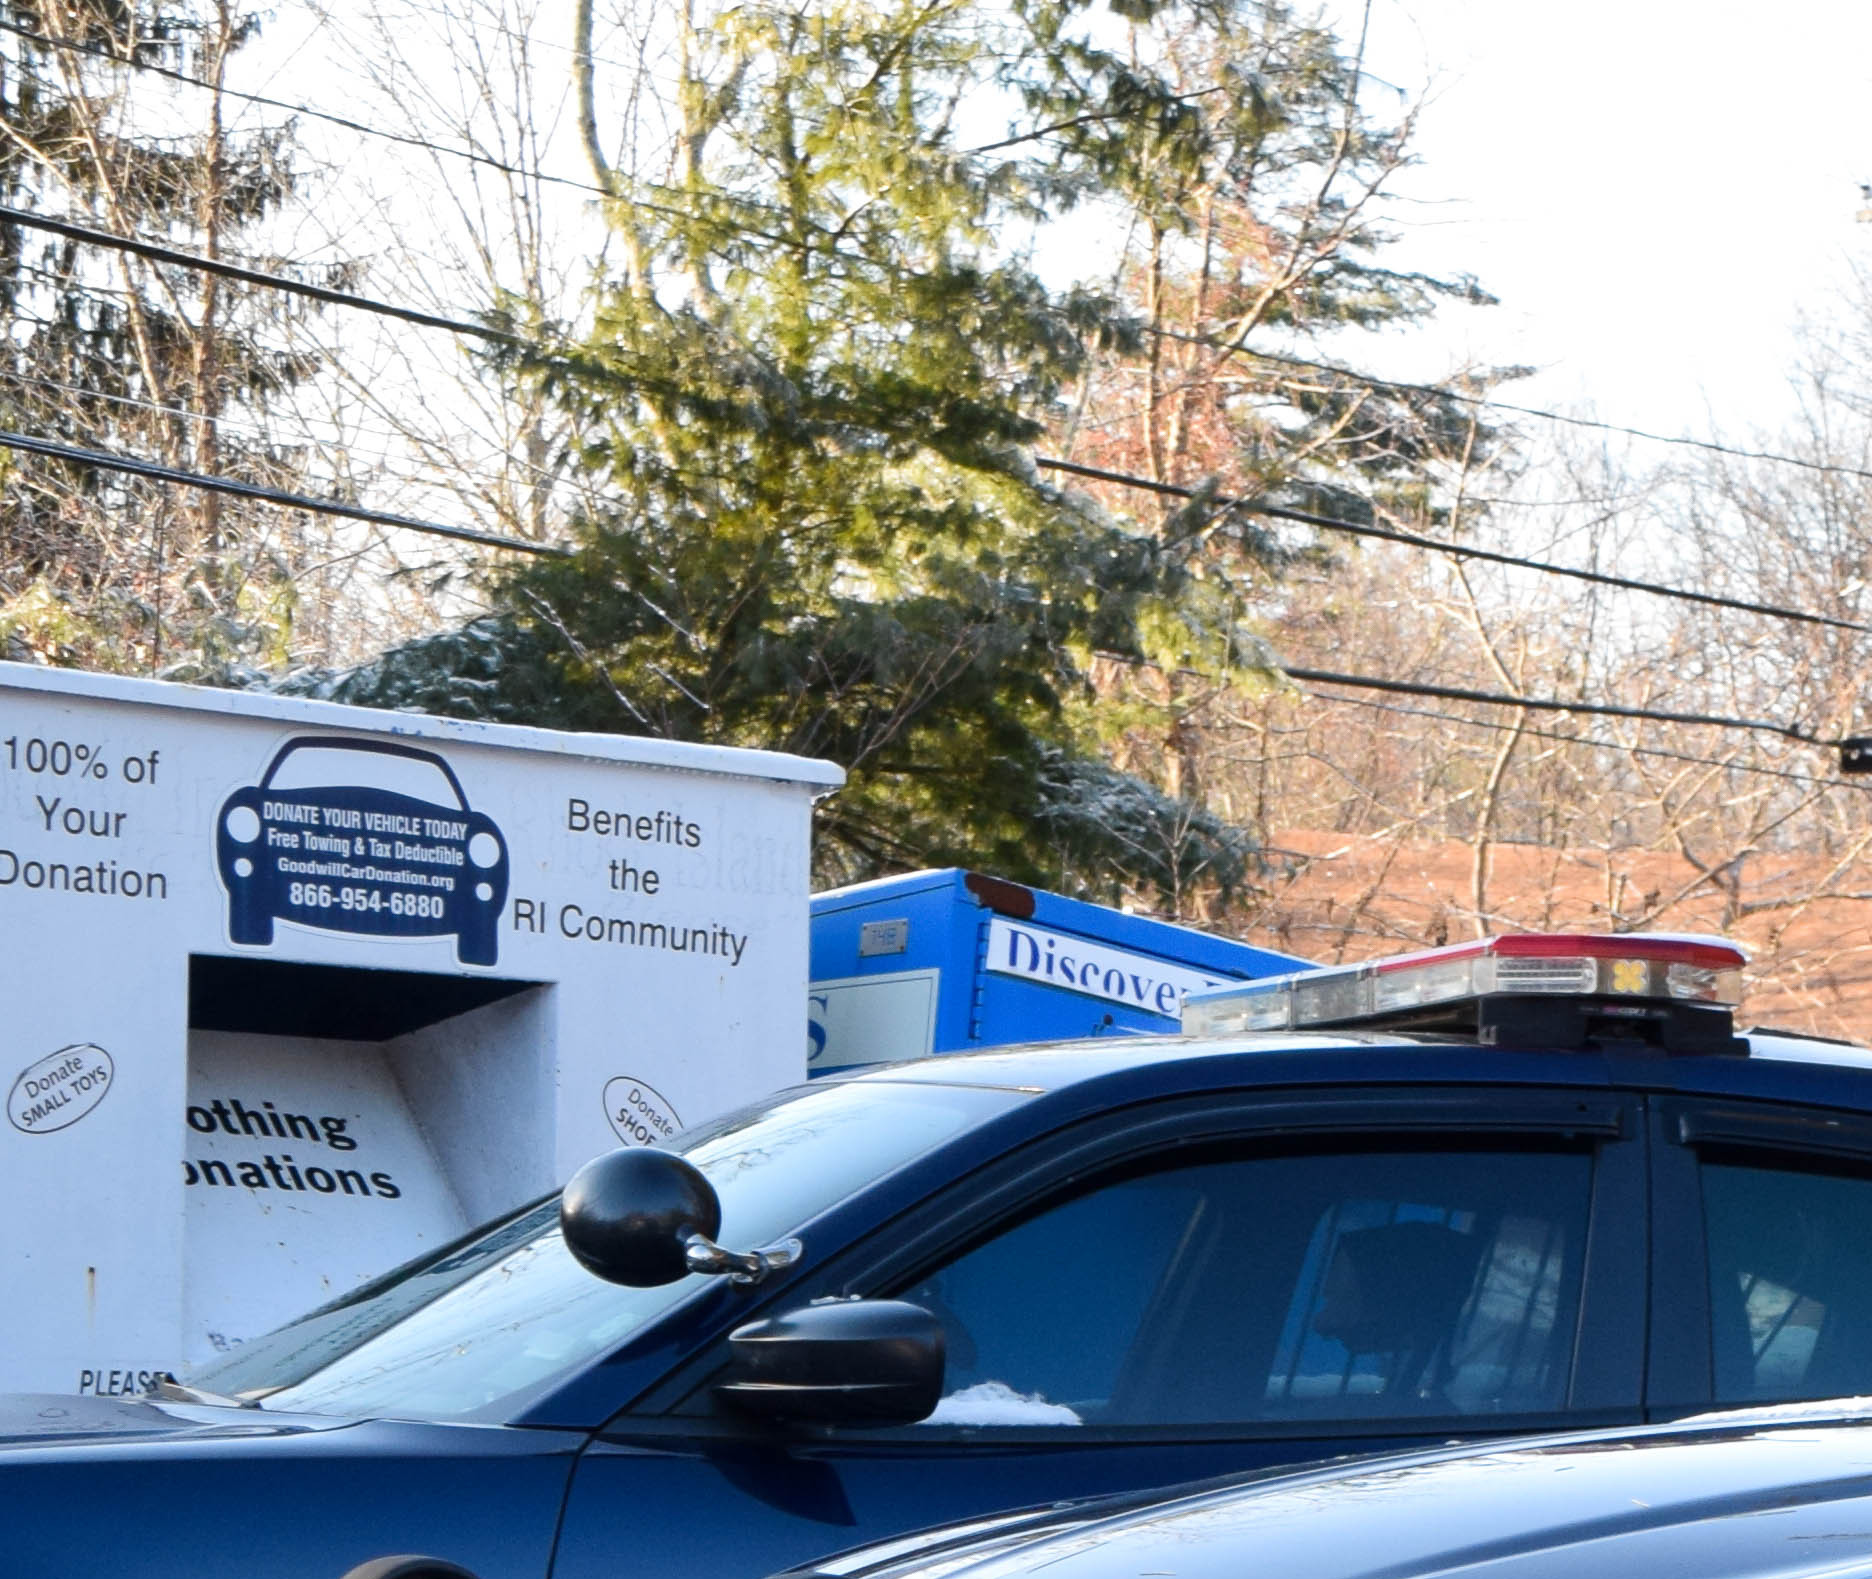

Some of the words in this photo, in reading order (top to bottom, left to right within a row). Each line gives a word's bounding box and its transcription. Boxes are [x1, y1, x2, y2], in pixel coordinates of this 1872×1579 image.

[4, 736, 109, 779] 100%
[123, 750, 160, 785] of
[36, 795, 128, 838] Your
[263, 801, 320, 825] DONATE
[323, 808, 361, 830] YOUR
[364, 812, 421, 836] VEHICLE
[423, 818, 468, 841] TODAY
[567, 798, 702, 848] Benefits
[267, 827, 300, 849] Free
[302, 831, 350, 858] Towing
[353, 837, 365, 856] &
[368, 838, 392, 859] Tax
[395, 841, 465, 867] Deductible
[0, 849, 168, 899] Donation
[277, 857, 456, 892] GoodwillCarDonation.org
[608, 858, 660, 895] the
[289, 882, 445, 920] 866-954-6880
[513, 898, 546, 934] RI
[559, 904, 748, 967] Community
[1007, 927, 1193, 1014] Discove
[21, 1088, 71, 1127] SMALL
[70, 1065, 108, 1096] TOYS
[24, 1057, 83, 1099] Donate
[627, 1088, 674, 1137] Donate
